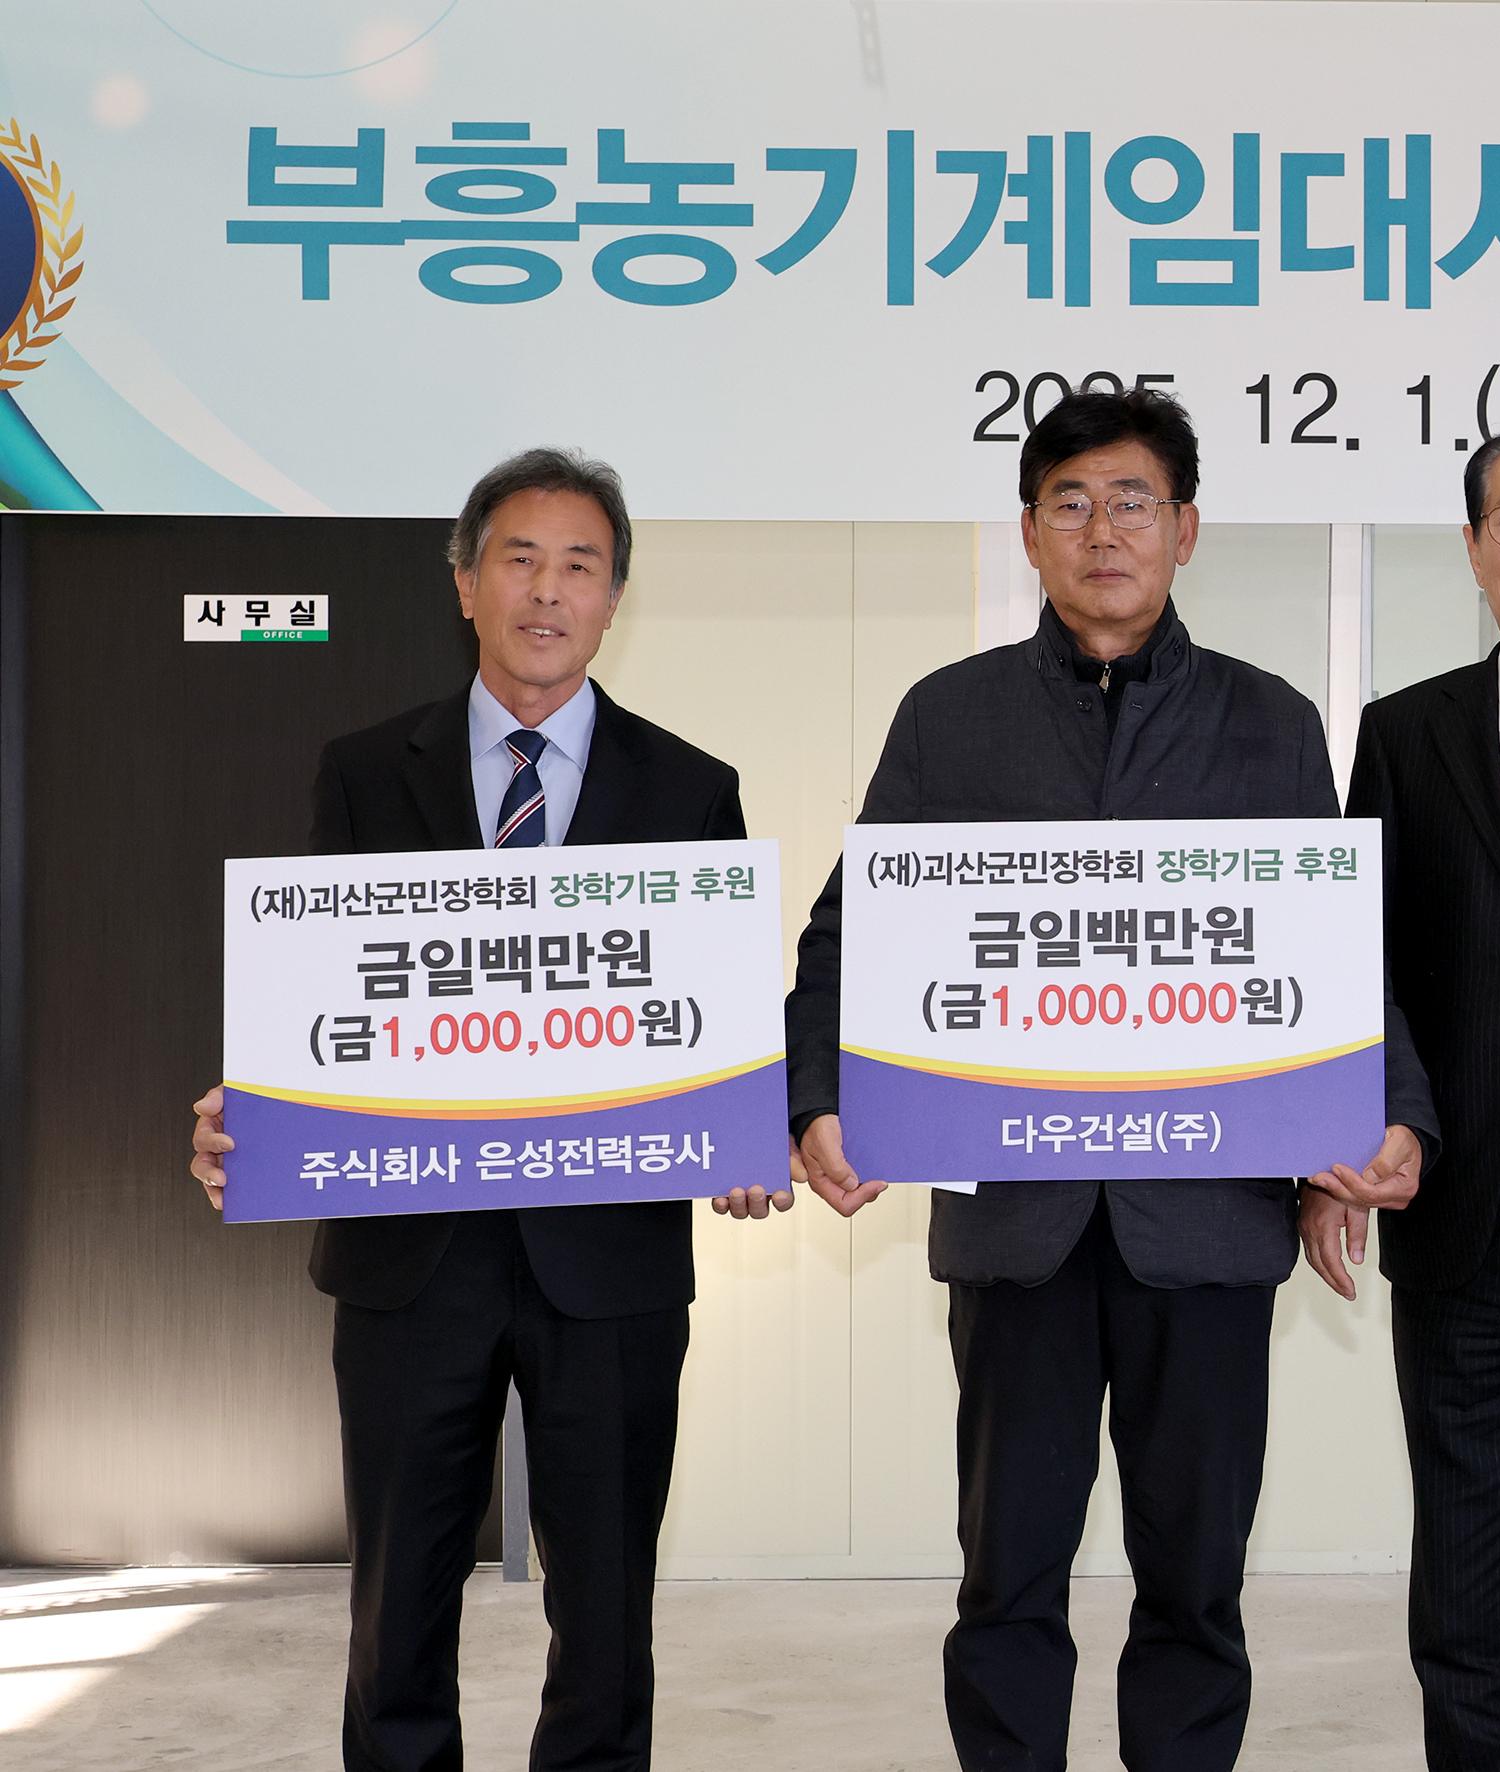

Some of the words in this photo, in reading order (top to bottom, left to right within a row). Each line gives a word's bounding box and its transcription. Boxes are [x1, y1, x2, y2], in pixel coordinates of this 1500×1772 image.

[1246, 373, 1360, 450] 12.
[198, 600, 315, 626] 사무실
[263, 631, 303, 639] OFFICE
[250, 875, 537, 922] (재)괴산군민장학회
[549, 870, 680, 907] 장학기금
[690, 866, 756, 901] 후원
[868, 850, 1144, 888] (재)괴산군민장학회
[1157, 849, 1284, 882] 장학기금
[1294, 847, 1358, 881] 후원
[357, 929, 653, 1000] 금일백만원
[969, 906, 1255, 968] 금일백만원
[310, 997, 702, 1066] (금1,000,000원)
[922, 976, 1303, 1032] (금1,000,000원)
[1001, 1111, 1222, 1153] 다우건설(주)
[300, 1144, 461, 1190] 주식회사
[476, 1131, 715, 1181] 은성전력공사
